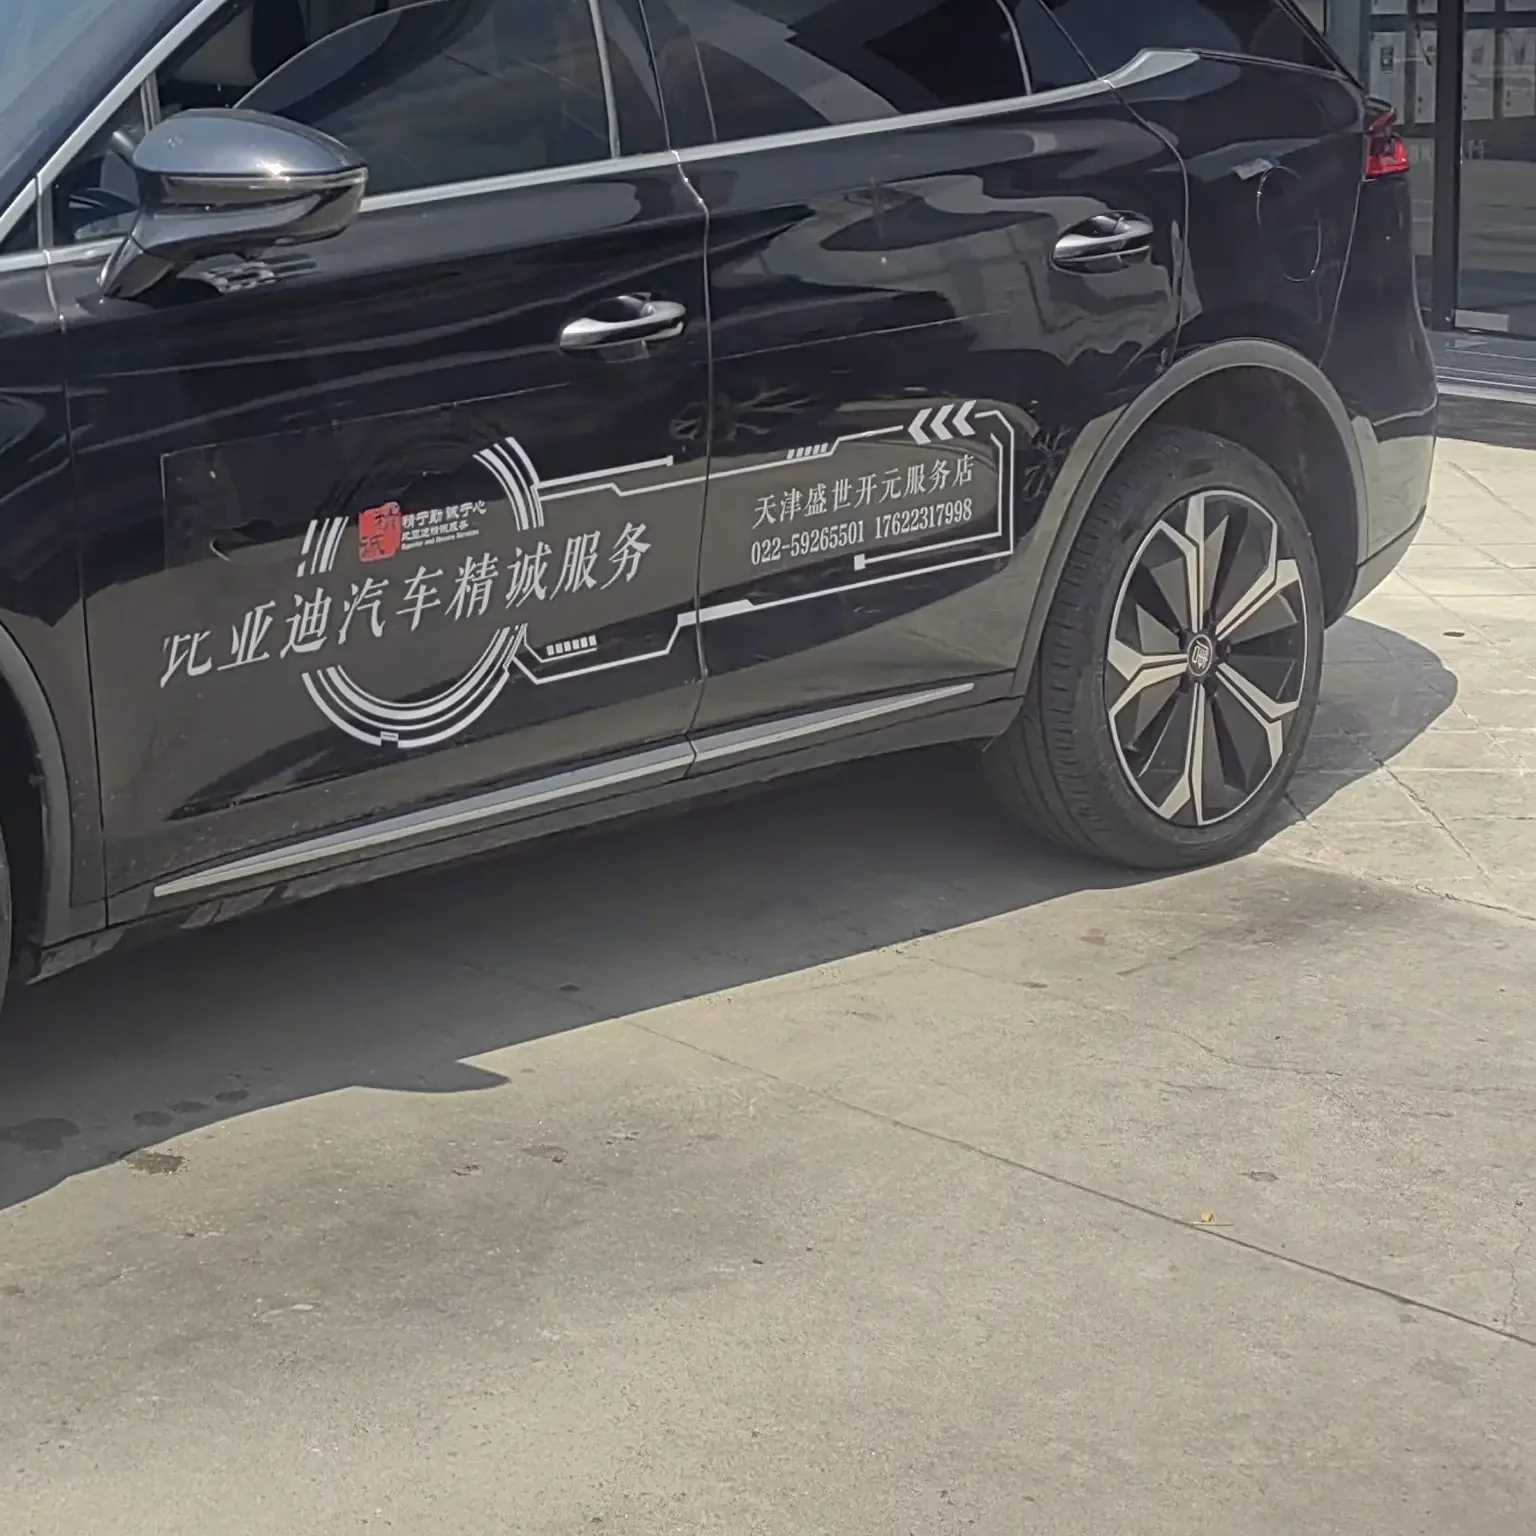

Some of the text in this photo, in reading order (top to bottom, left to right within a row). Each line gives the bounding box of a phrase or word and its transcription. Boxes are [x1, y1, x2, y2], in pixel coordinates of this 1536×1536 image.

[751, 454, 975, 530] 天津盛世开元服务店
[751, 497, 973, 565] 022-59265501 17622317998
[160, 522, 653, 689] 比亚迪汽车精诚服务
